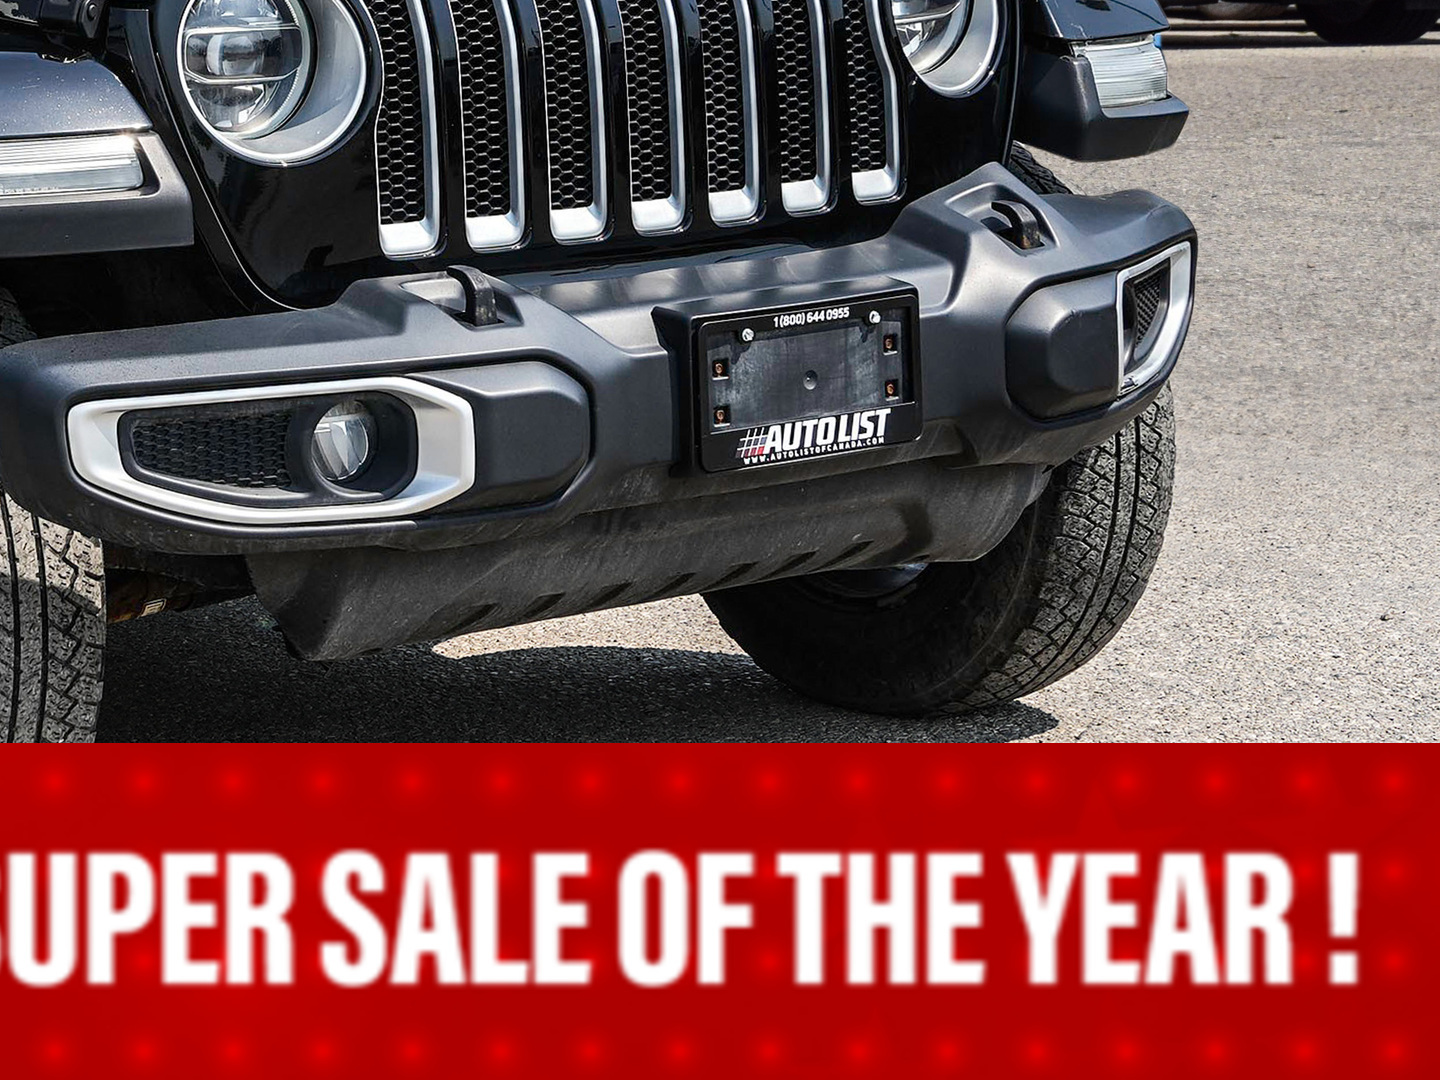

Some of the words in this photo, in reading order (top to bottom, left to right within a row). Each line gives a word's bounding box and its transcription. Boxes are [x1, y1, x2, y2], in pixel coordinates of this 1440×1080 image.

[773, 316, 779, 328] 1
[779, 312, 806, 328] (800)
[806, 310, 825, 323] 644
[826, 306, 850, 320] 0955
[743, 436, 885, 465] WWW.AUTOLISTOFCANADA.COM
